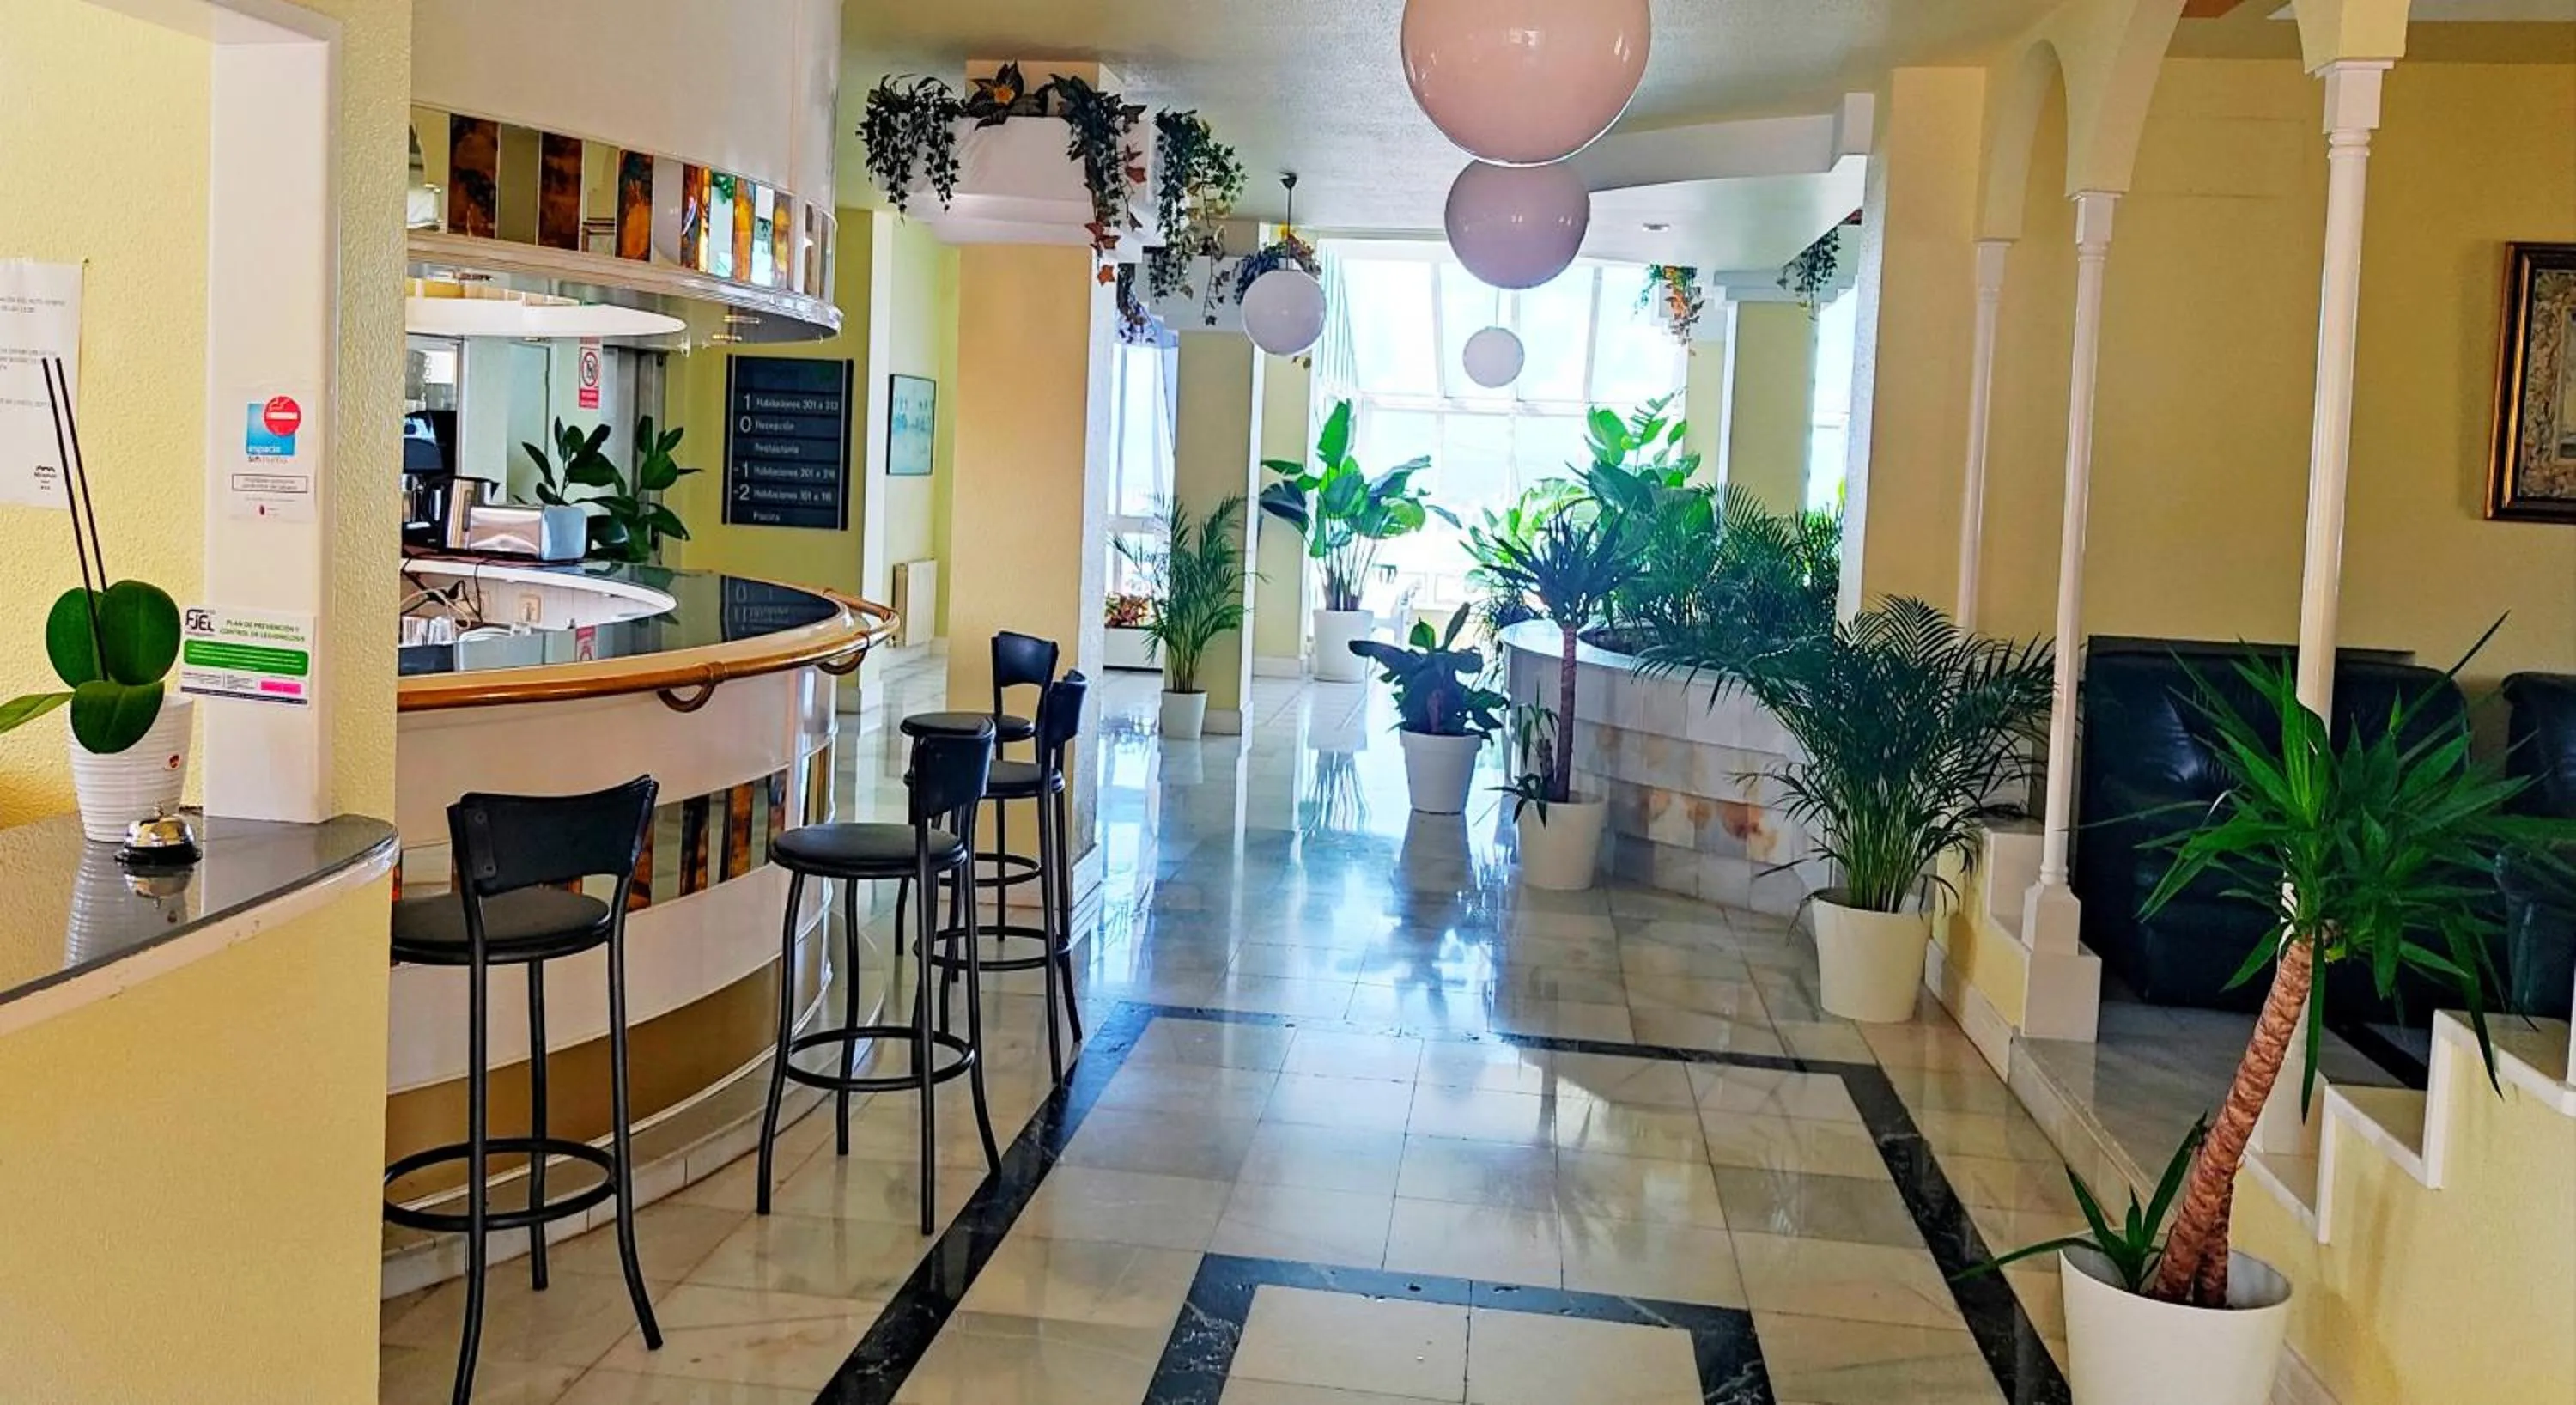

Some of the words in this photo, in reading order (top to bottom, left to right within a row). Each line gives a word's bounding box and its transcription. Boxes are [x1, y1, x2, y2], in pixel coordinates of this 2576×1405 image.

[744, 394, 751, 410] 1
[756, 398, 801, 409] Habitaciones
[740, 416, 751, 433] 0
